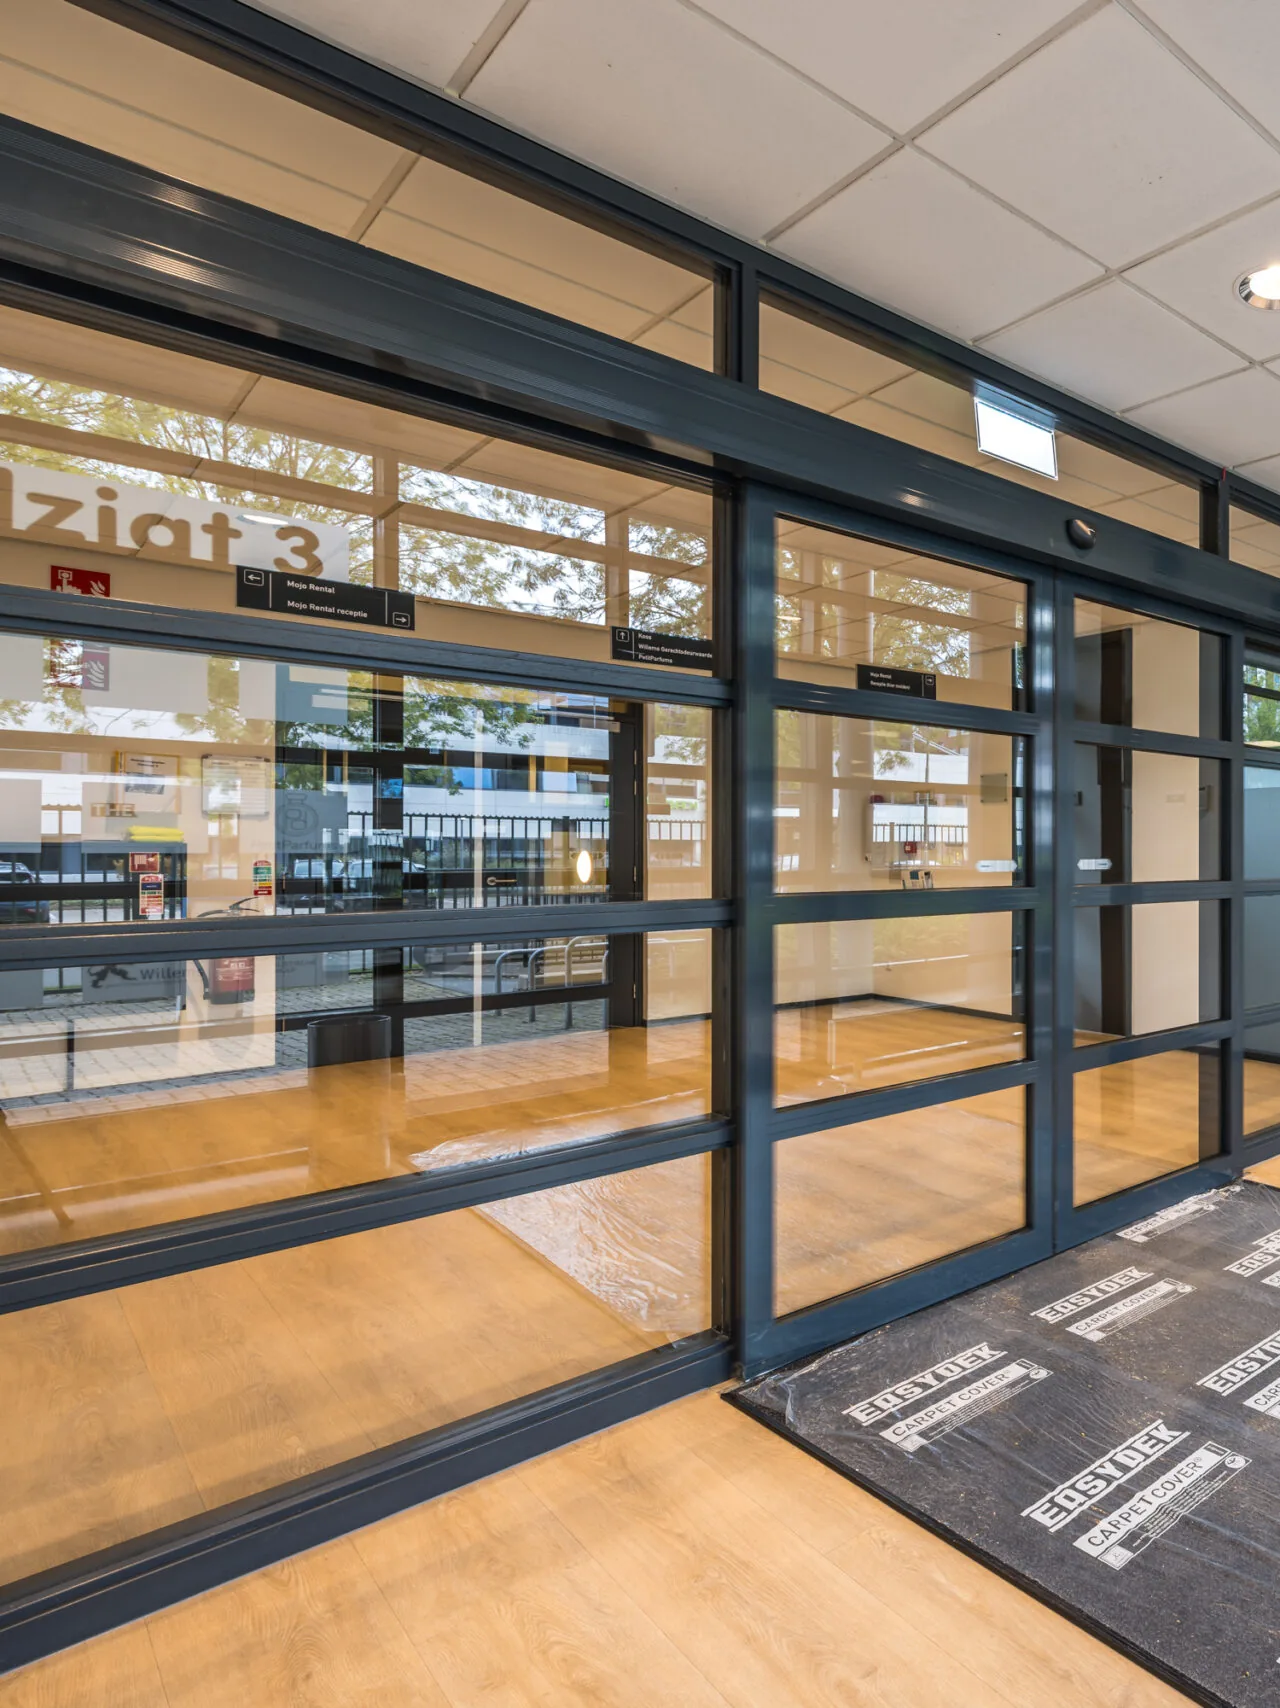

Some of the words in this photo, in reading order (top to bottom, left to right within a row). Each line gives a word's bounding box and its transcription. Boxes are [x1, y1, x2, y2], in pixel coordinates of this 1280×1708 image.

[273, 526, 323, 577] 3
[287, 580, 307, 590] Mojo
[309, 583, 336, 594] Rental
[287, 600, 308, 610] Mojo
[309, 604, 335, 614] Rental
[337, 609, 368, 619] receptie
[1036, 1267, 1148, 1322] EASYDEK
[1075, 1305, 1122, 1332] CARPET
[1122, 1287, 1161, 1309] COVER
[849, 1344, 1002, 1423] EASYDEK
[892, 1400, 959, 1437] CARPET
[1029, 1423, 1183, 1527] EASYDEK
[1088, 1493, 1153, 1547] CARPET
